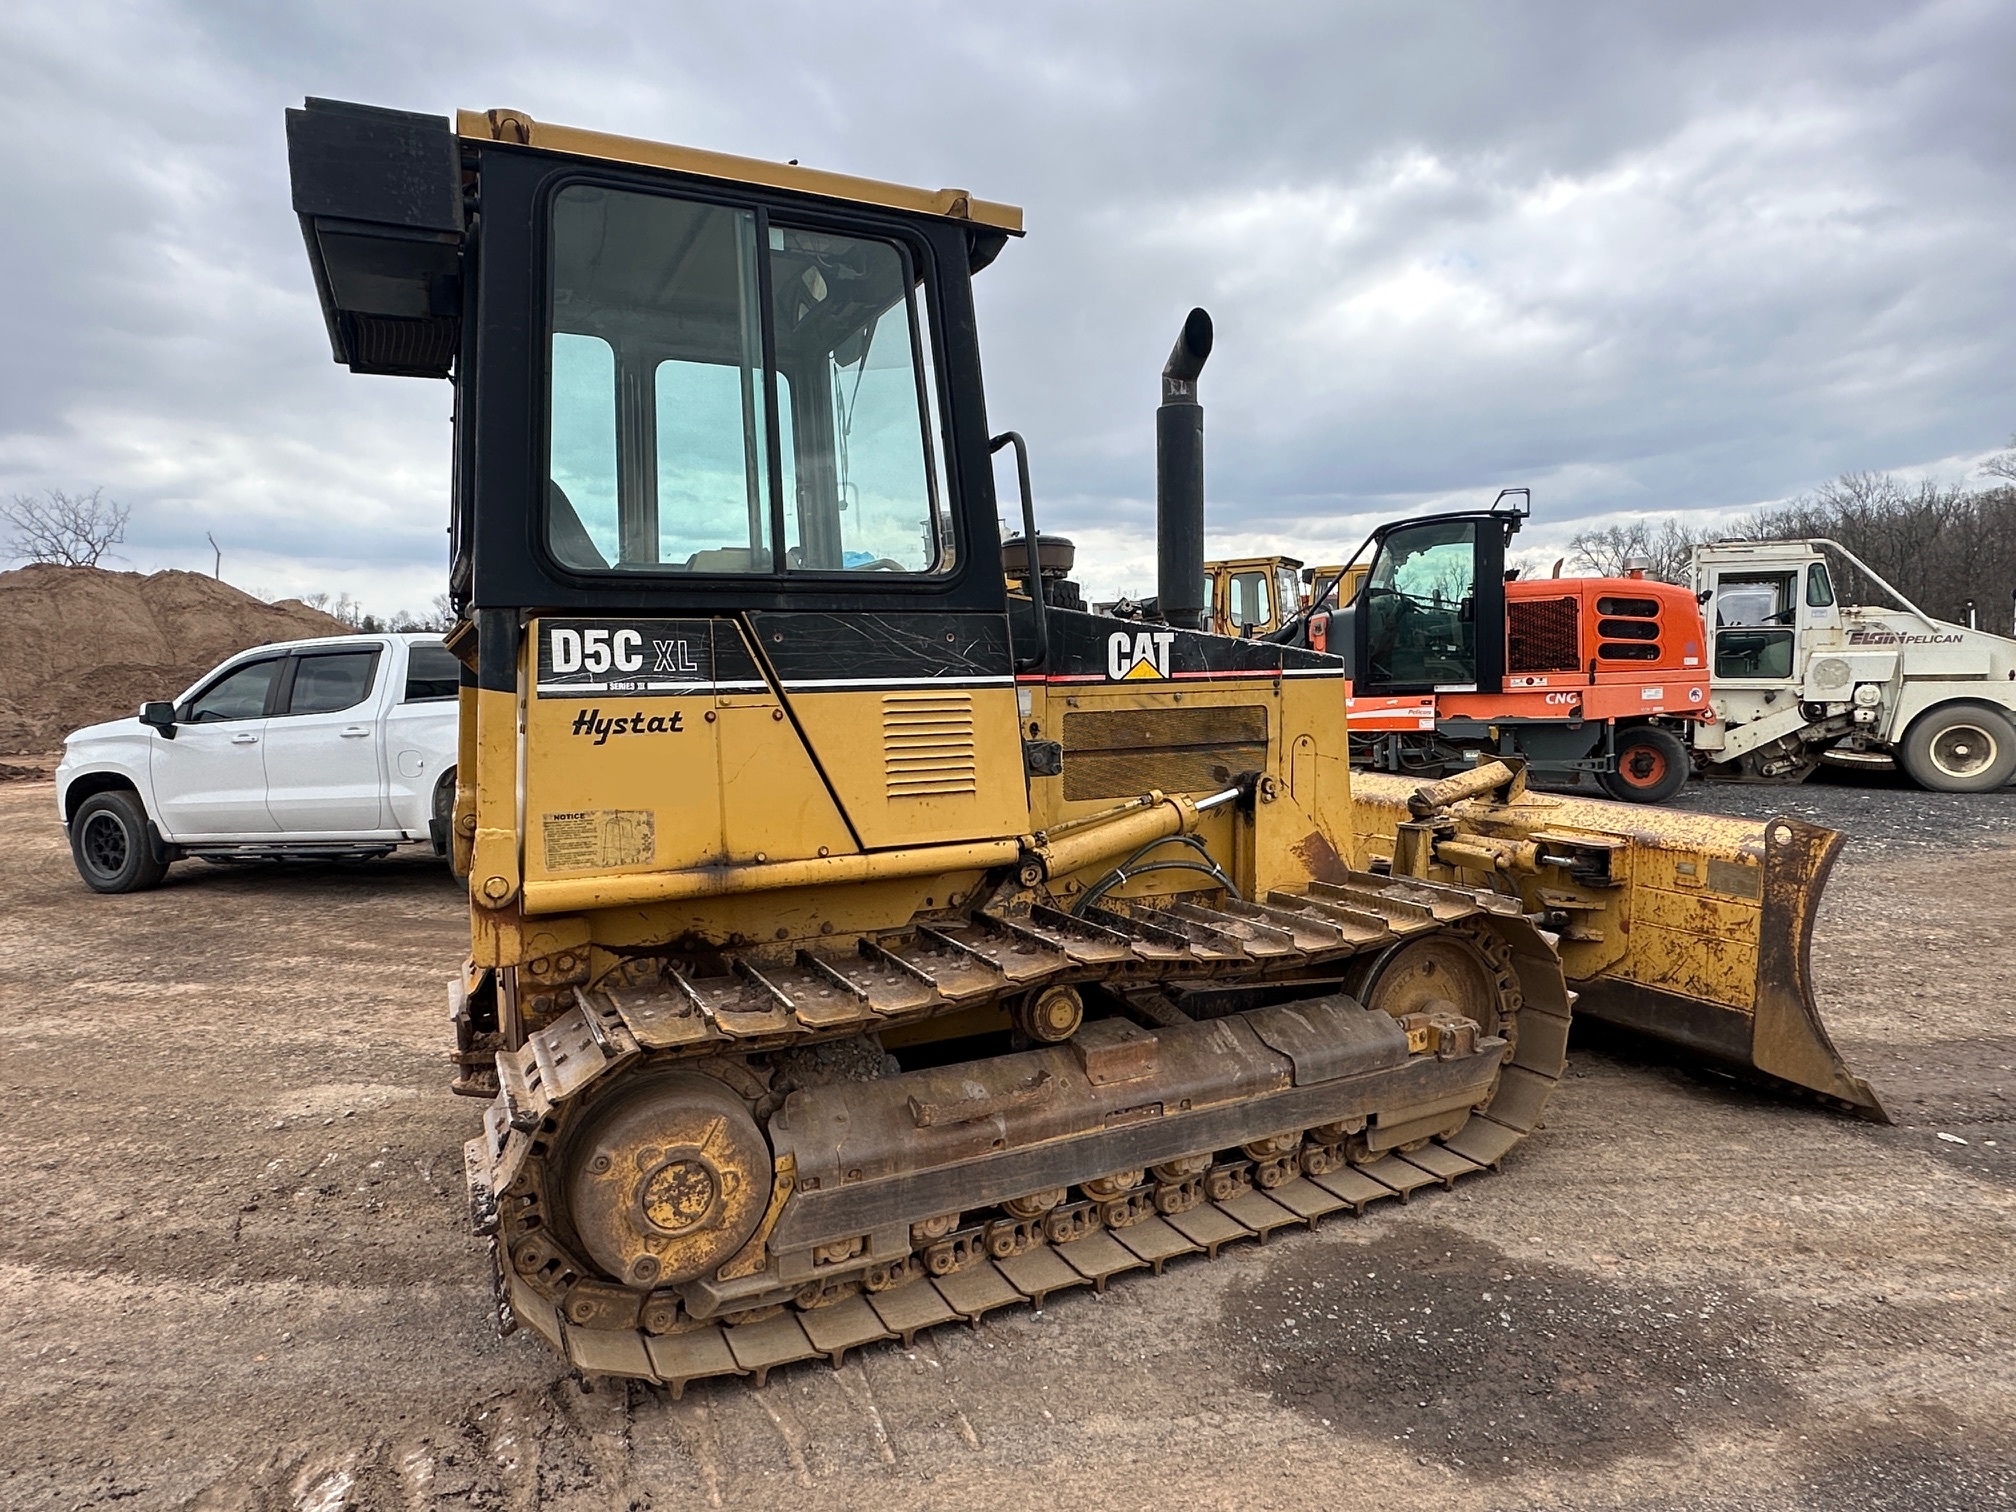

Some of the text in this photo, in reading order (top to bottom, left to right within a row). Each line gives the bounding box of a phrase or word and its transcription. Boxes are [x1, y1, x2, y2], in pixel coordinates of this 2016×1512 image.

[1848, 631, 1907, 646] ELGIN
[1905, 634, 1964, 645] PELICAN
[551, 629, 698, 673] D5C XL
[1108, 631, 1175, 680] CAT
[609, 682, 636, 691] SERIES
[1545, 692, 1578, 705] CNG
[572, 709, 684, 746] Hystat
[553, 812, 586, 821] NOTICE
